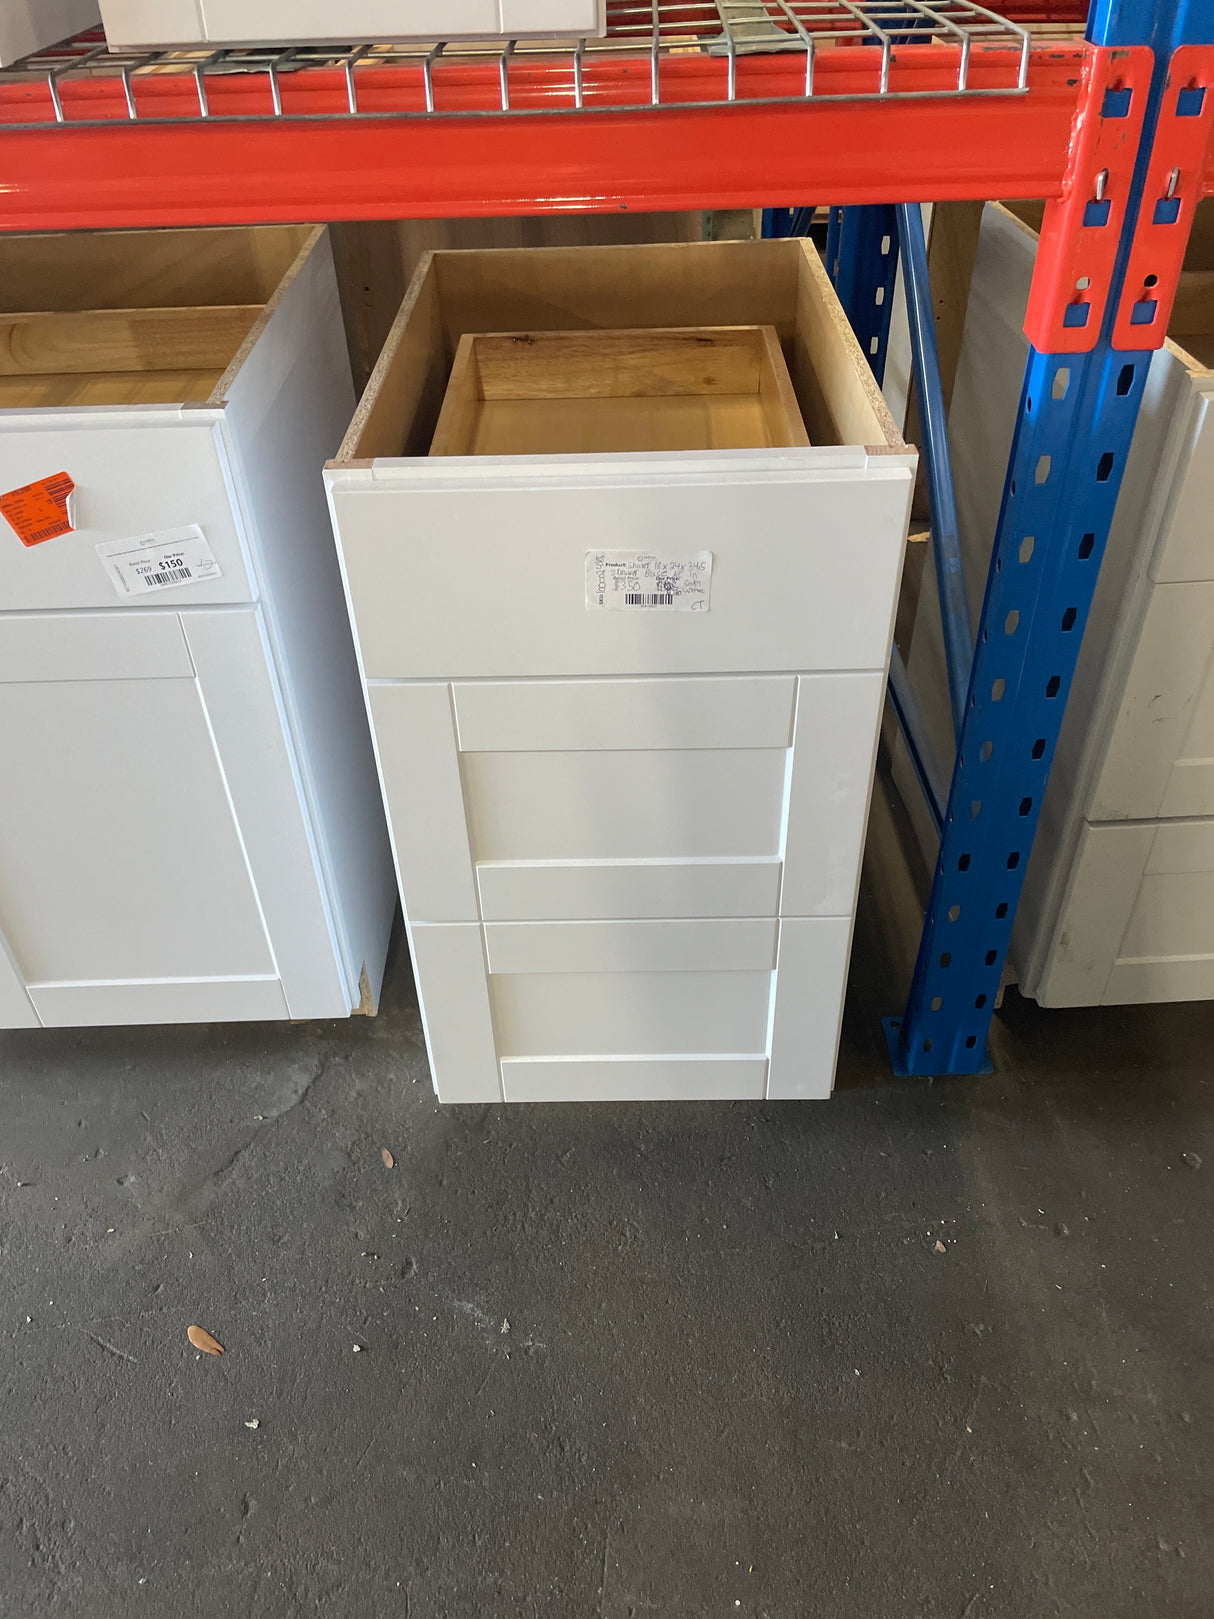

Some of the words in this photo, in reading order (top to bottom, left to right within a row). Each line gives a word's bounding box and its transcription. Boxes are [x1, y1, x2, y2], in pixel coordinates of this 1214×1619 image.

[158, 558, 183, 571] $150
[136, 566, 152, 575] $269
[644, 568, 668, 577] Base
